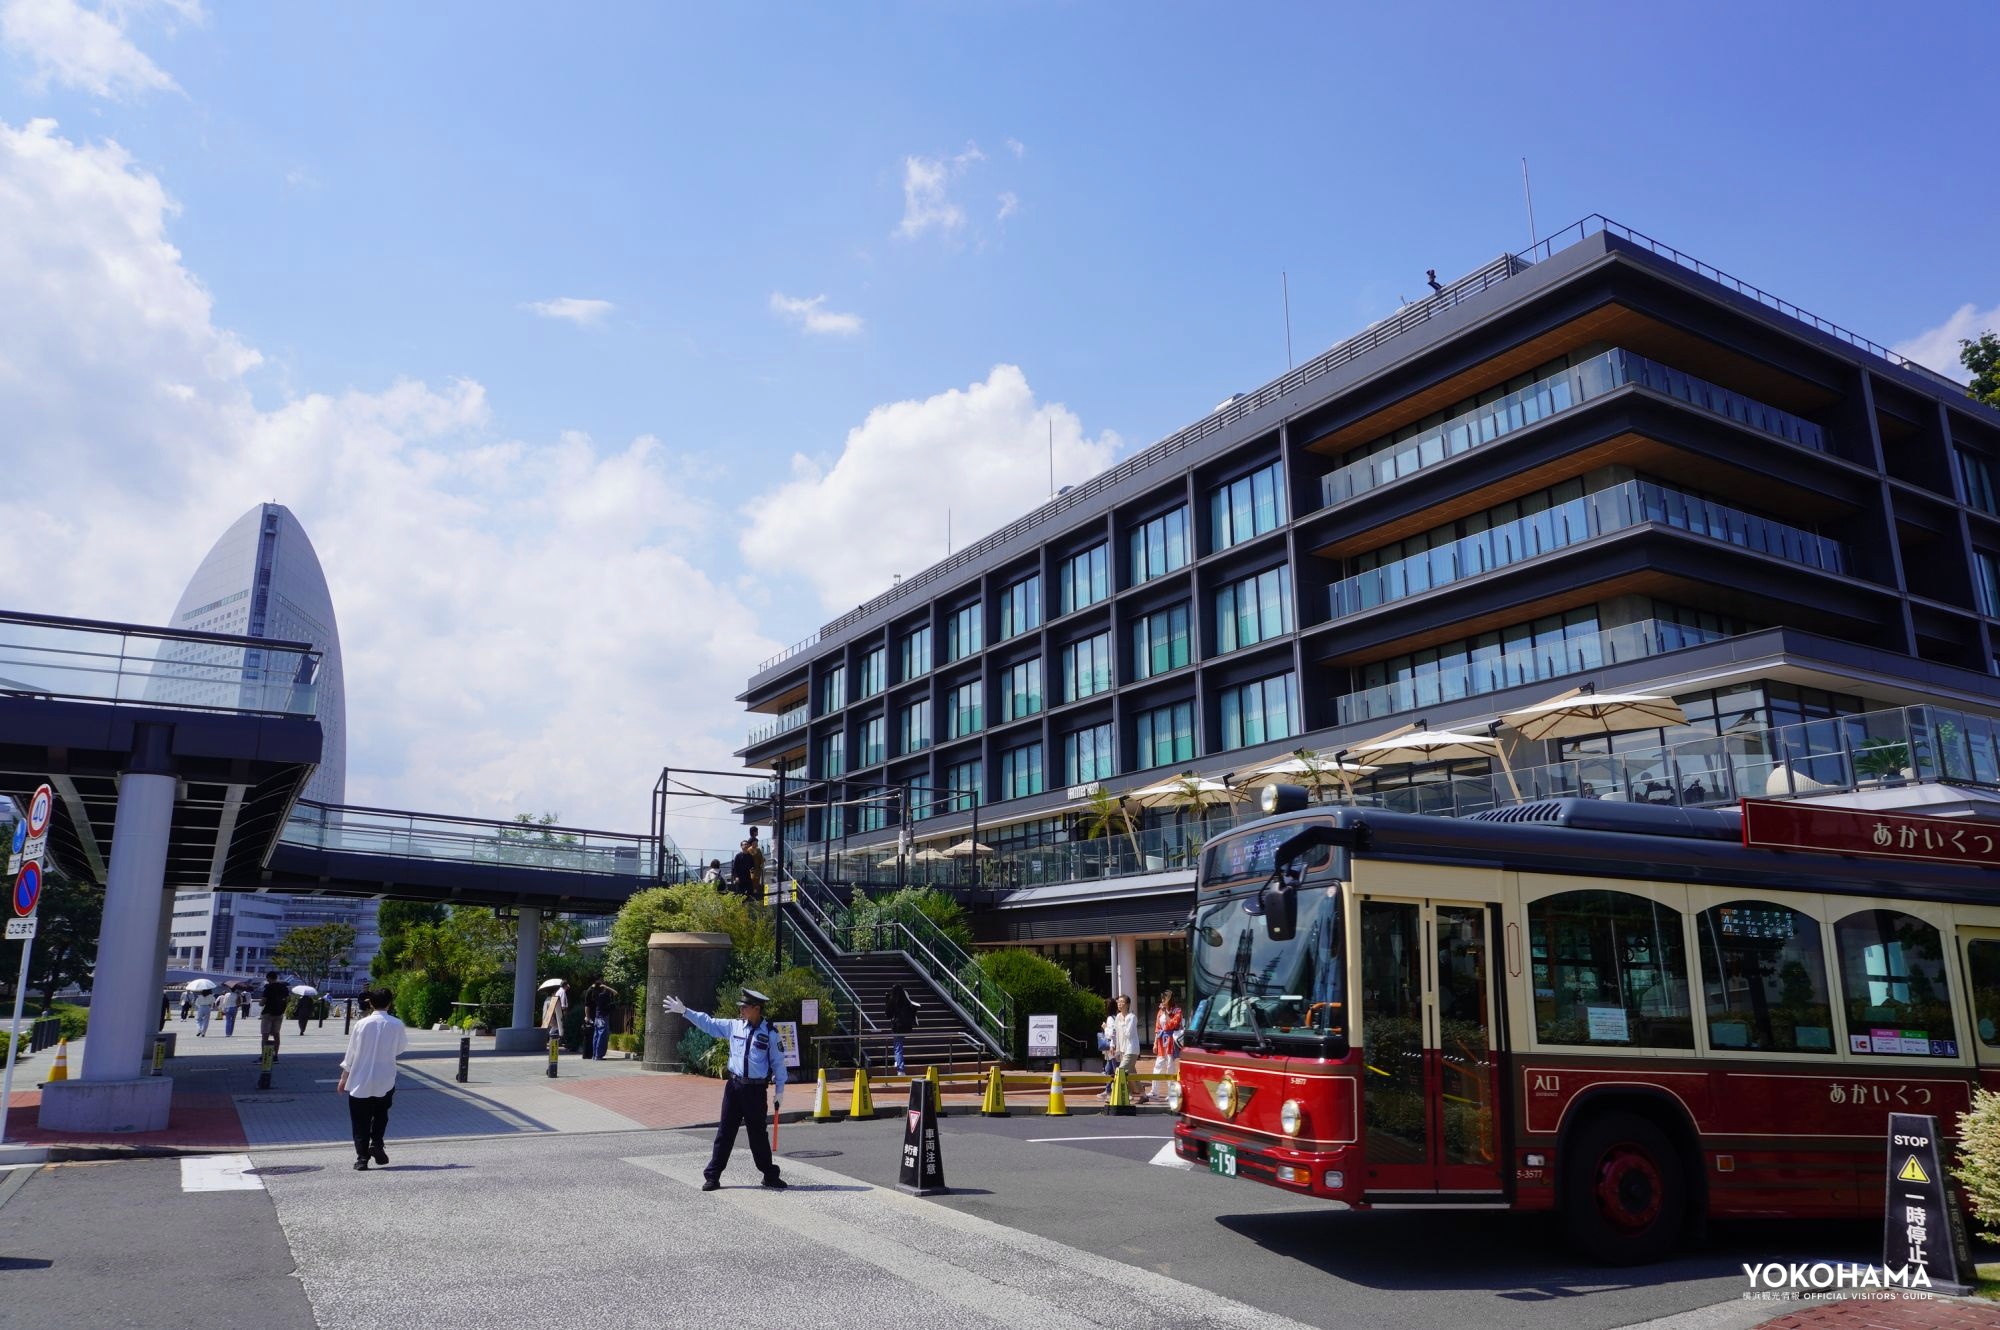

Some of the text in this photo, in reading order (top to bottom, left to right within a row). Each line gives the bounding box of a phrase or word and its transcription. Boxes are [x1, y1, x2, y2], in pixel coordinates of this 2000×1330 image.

[32, 800, 46, 822] 40
[25, 841, 43, 856] ここまで
[1872, 822, 1993, 853] あかいくつ
[8, 923, 34, 935] ここまで
[1533, 1074, 1560, 1091] 入口
[1829, 1083, 1932, 1105] あかいくつ
[925, 1128, 936, 1174] 車両注意
[1894, 1134, 1929, 1147] STOP
[1905, 1193, 1928, 1265] 一時停止
